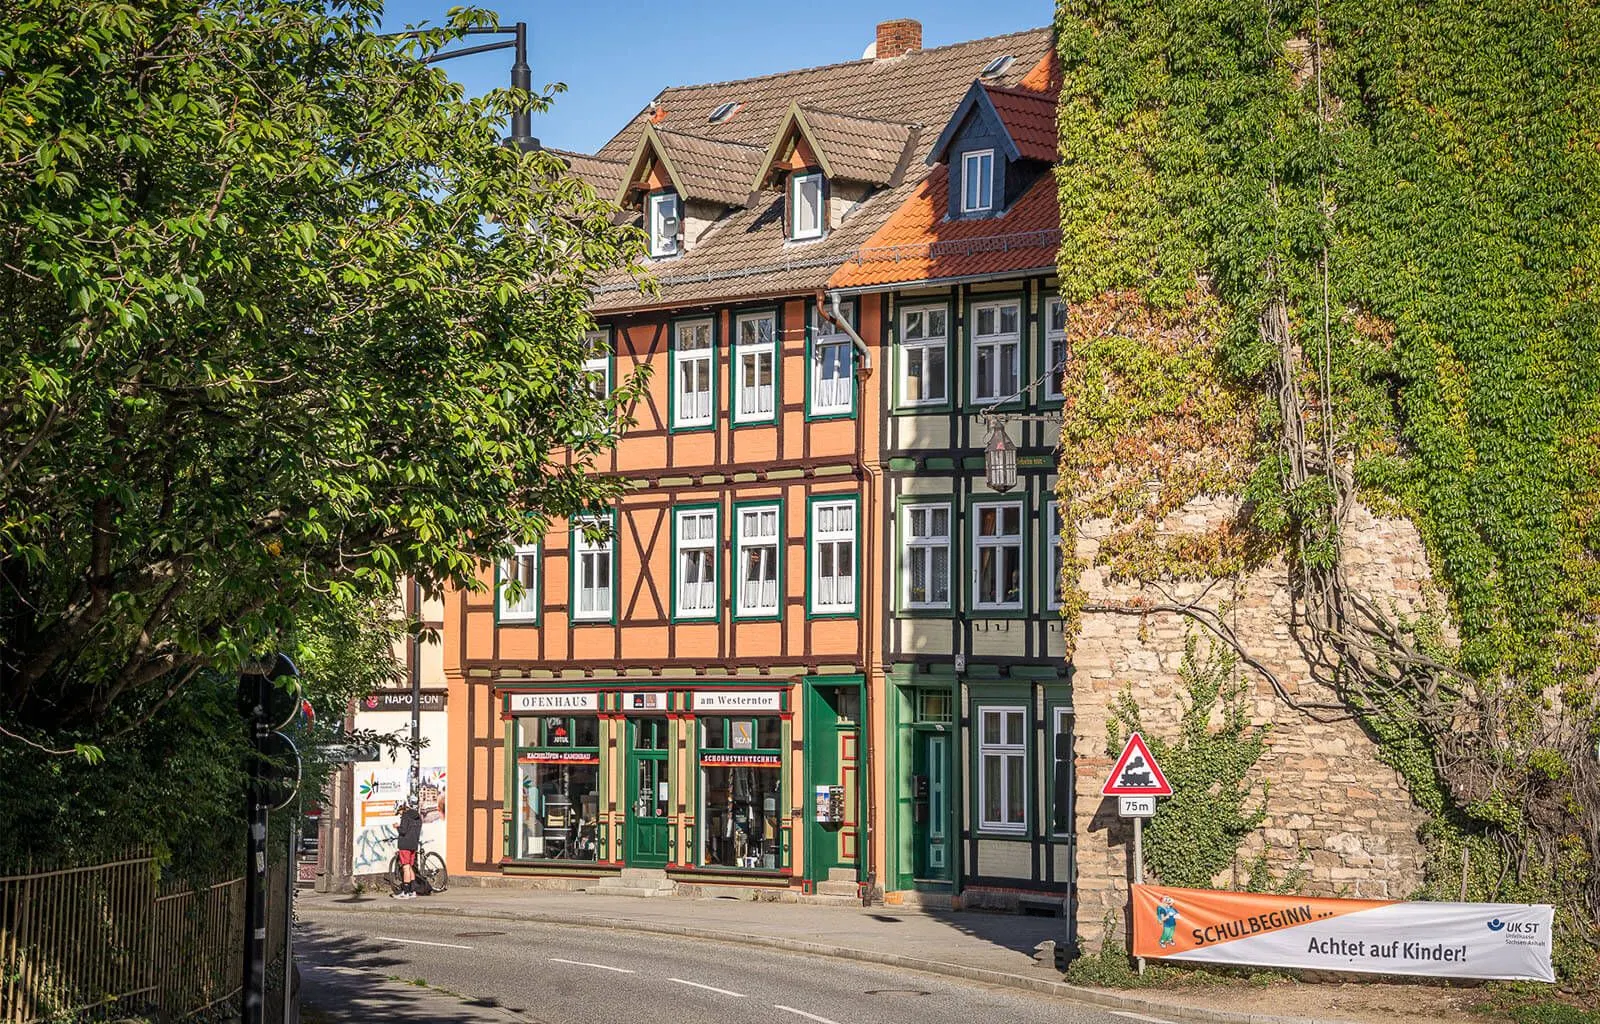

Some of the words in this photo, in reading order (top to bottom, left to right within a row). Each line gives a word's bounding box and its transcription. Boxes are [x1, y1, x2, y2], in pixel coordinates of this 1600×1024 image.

[384, 695, 439, 705] NAPOEON
[522, 696, 588, 707] OFENHAUS
[718, 696, 773, 705] Westerntor
[704, 755, 778, 763] SCHORNSTEINTECHNIK
[1192, 904, 1312, 946] SCHULBEGINN
[1506, 922, 1522, 933] UK
[1524, 922, 1540, 933] ST
[1307, 936, 1364, 956] Achtet
[1370, 940, 1399, 959] auf
[1403, 941, 1467, 962] Kinder!
